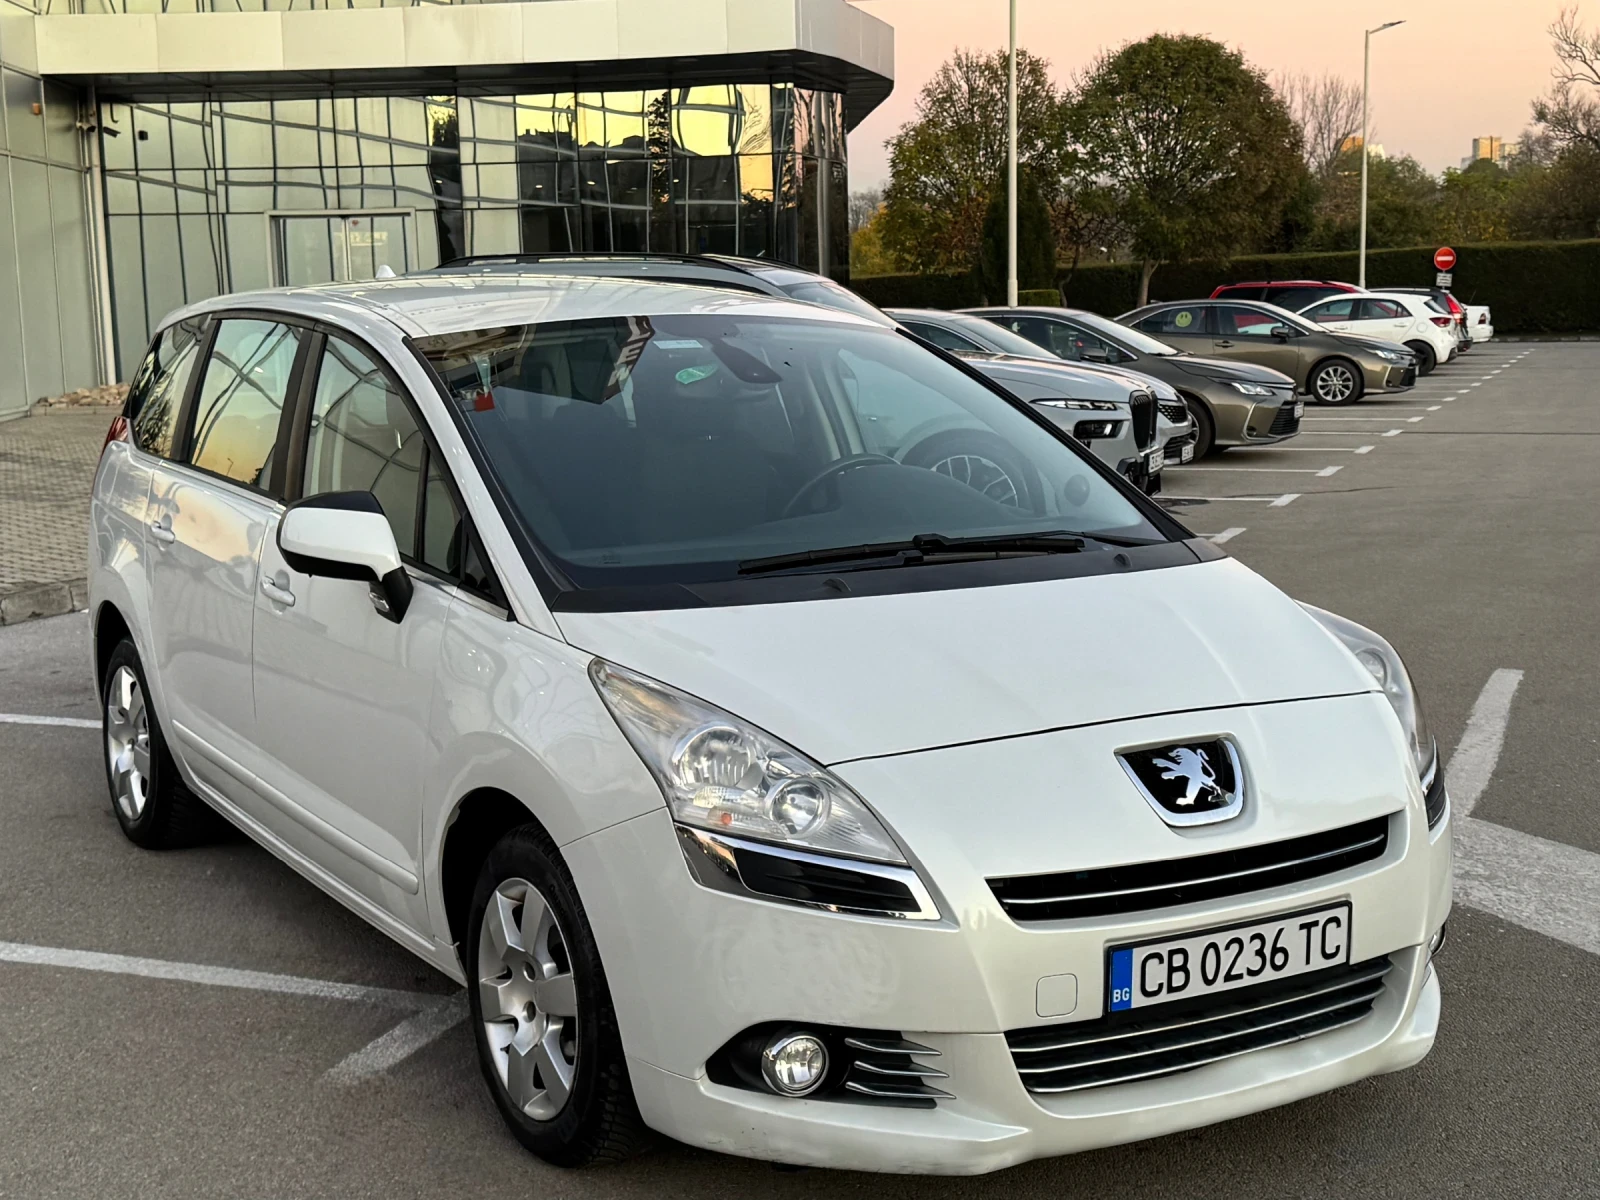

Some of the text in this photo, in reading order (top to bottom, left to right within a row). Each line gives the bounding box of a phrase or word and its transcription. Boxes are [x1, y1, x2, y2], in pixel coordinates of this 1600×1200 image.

[1140, 916, 1342, 998] CB 0236 TC
[1113, 987, 1131, 1003] BG
